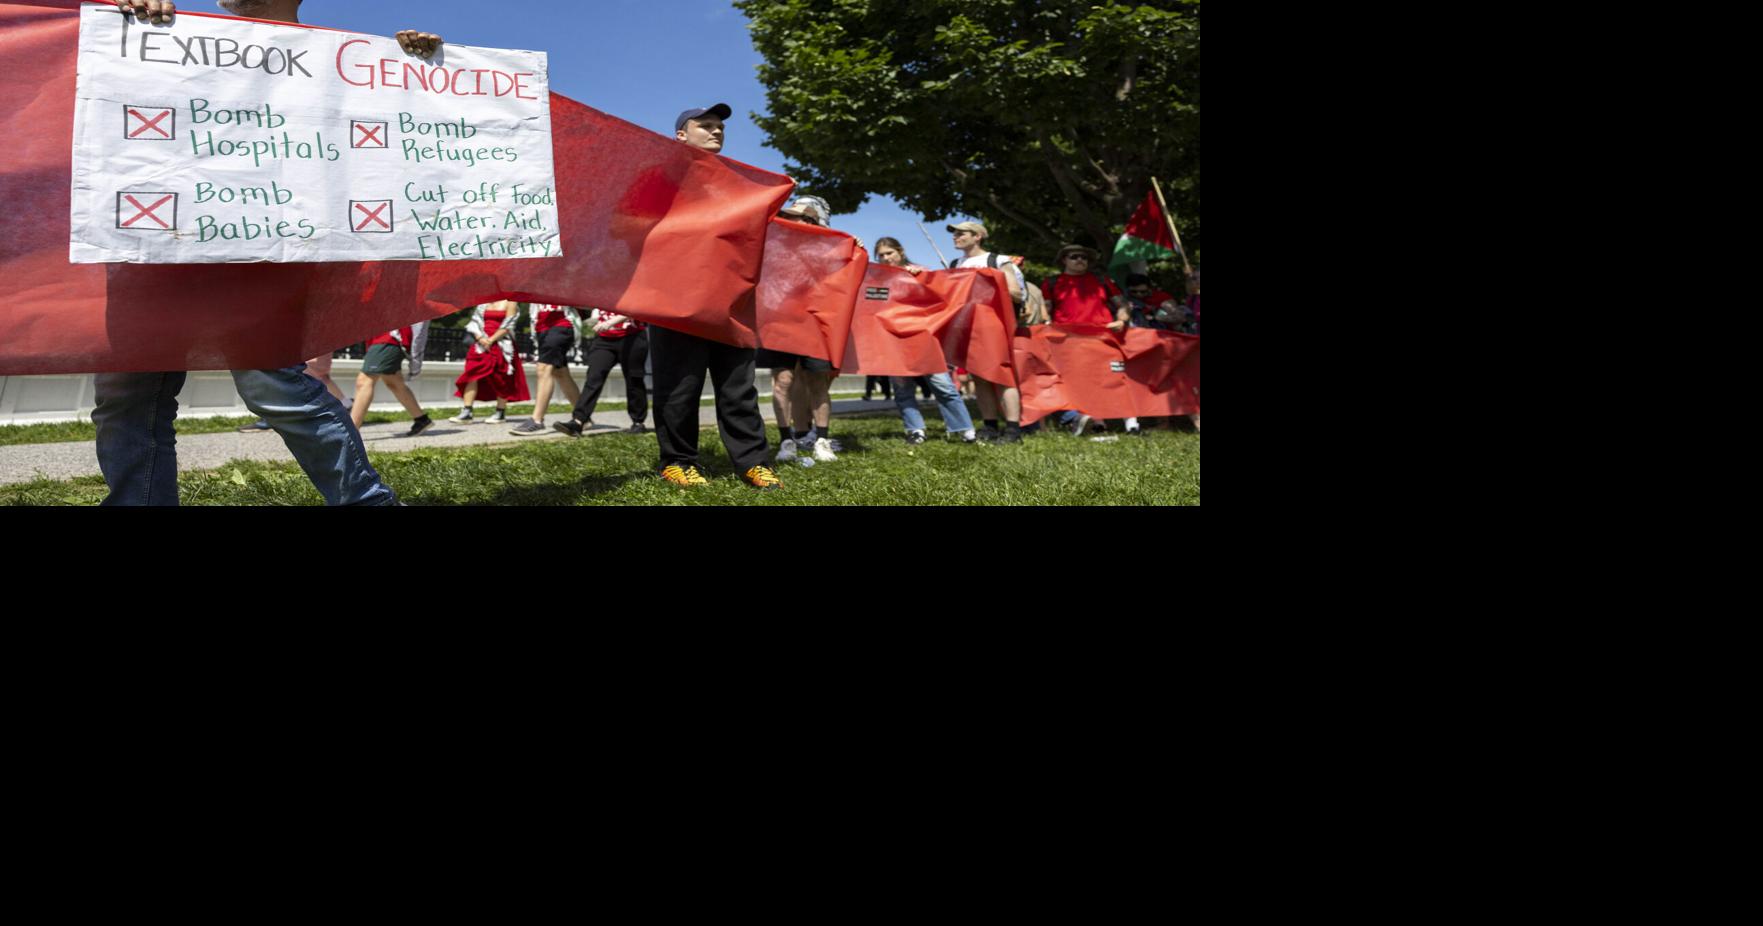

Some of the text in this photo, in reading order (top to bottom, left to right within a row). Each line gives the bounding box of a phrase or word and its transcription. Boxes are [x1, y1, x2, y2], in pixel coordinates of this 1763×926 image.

[95, 8, 538, 100] TEXTBOOK GENOCIDE
[190, 98, 286, 128] Bomb
[398, 112, 477, 139] Bomb
[190, 129, 340, 167] Hospitals
[402, 138, 518, 167] Refugees
[194, 181, 293, 206] Bomb
[404, 181, 449, 203] Cut
[462, 181, 500, 204] off
[194, 214, 316, 243] Babies
[417, 234, 552, 259] Electricity
